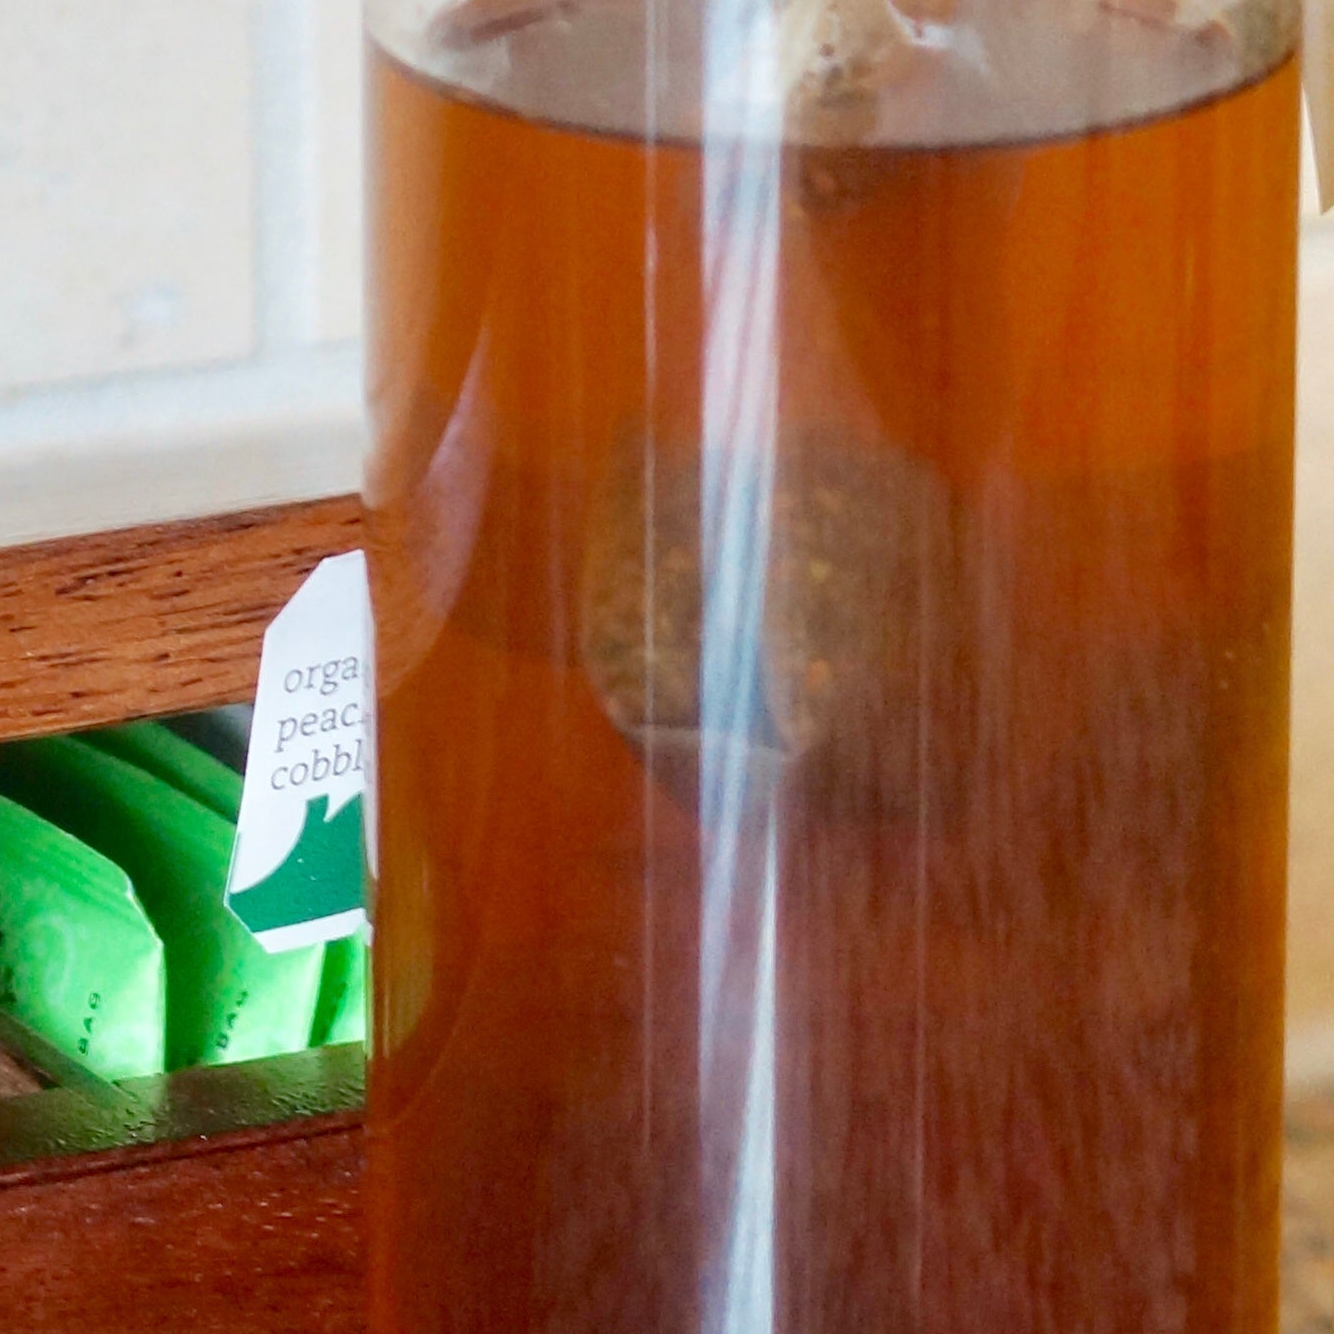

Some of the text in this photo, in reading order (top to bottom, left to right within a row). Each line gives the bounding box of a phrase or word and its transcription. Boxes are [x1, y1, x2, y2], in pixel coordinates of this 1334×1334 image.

[283, 655, 366, 697] orga
[274, 701, 367, 754] peac
[270, 738, 369, 791] cobbl
